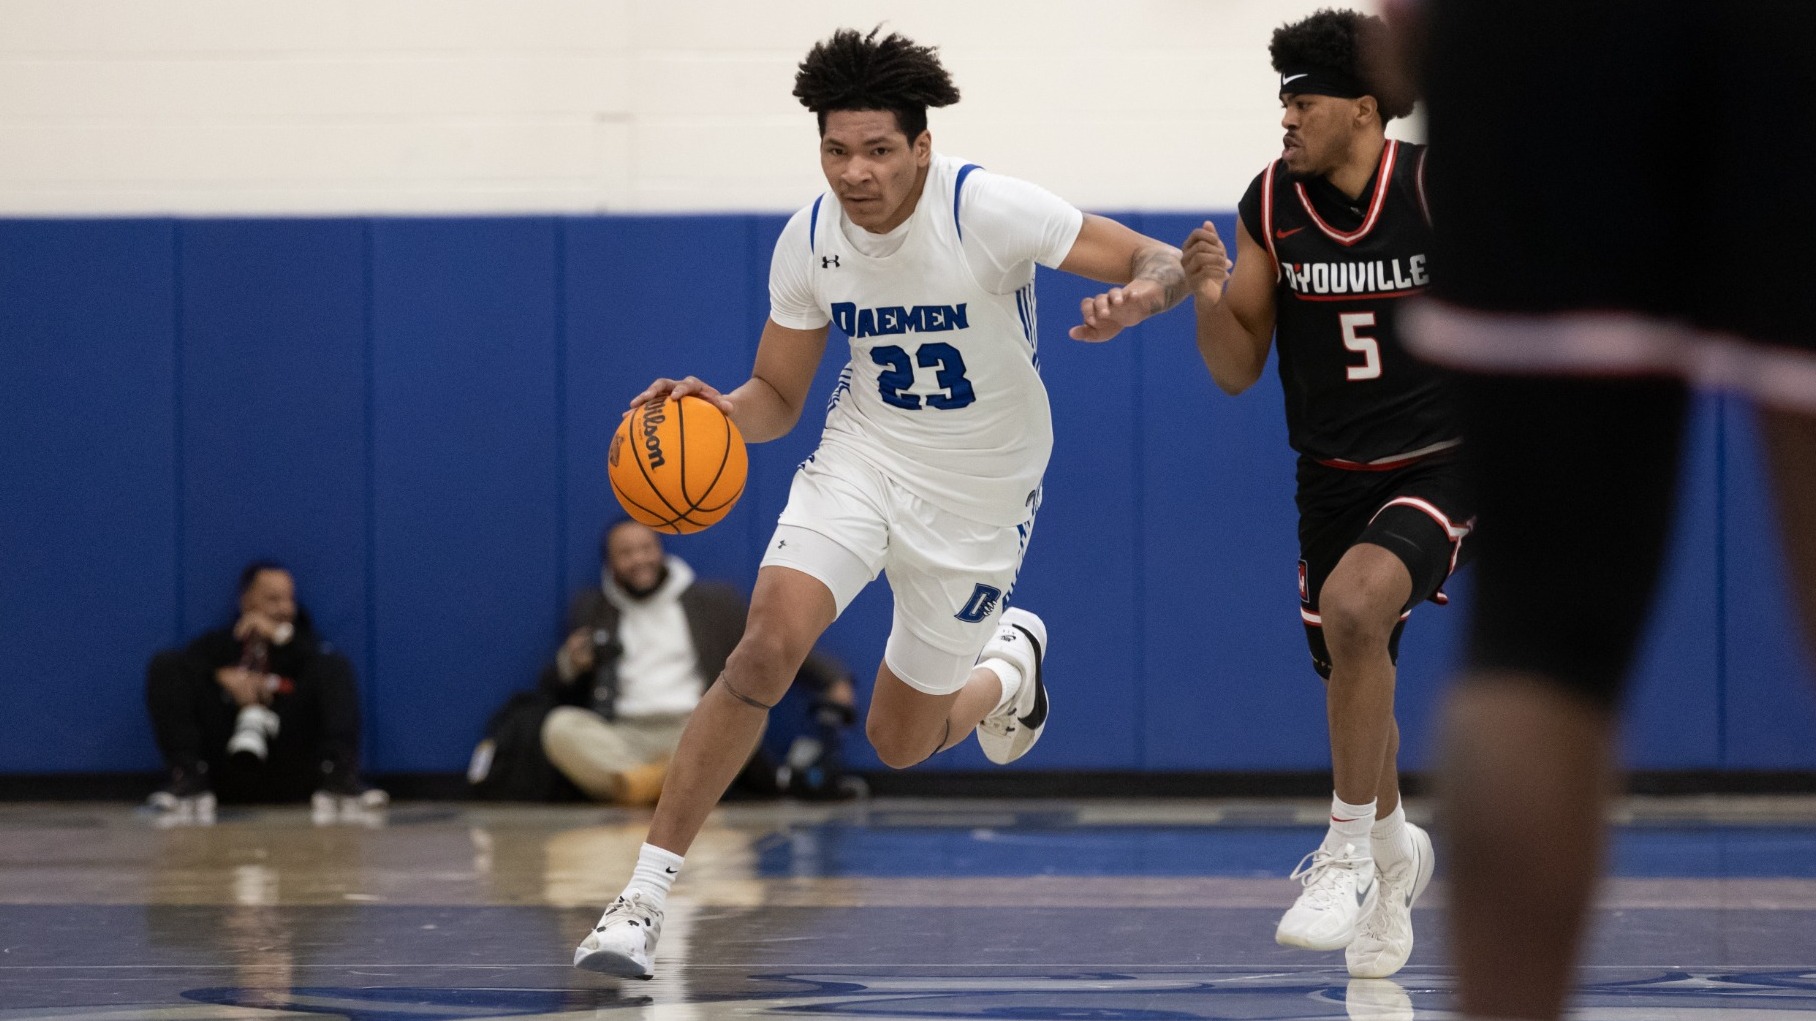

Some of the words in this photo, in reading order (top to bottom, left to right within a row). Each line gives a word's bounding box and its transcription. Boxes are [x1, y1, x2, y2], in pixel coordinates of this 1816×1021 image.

[831, 302, 970, 338] DAEMEN
[1338, 311, 1383, 381] 5
[869, 342, 976, 411] 23
